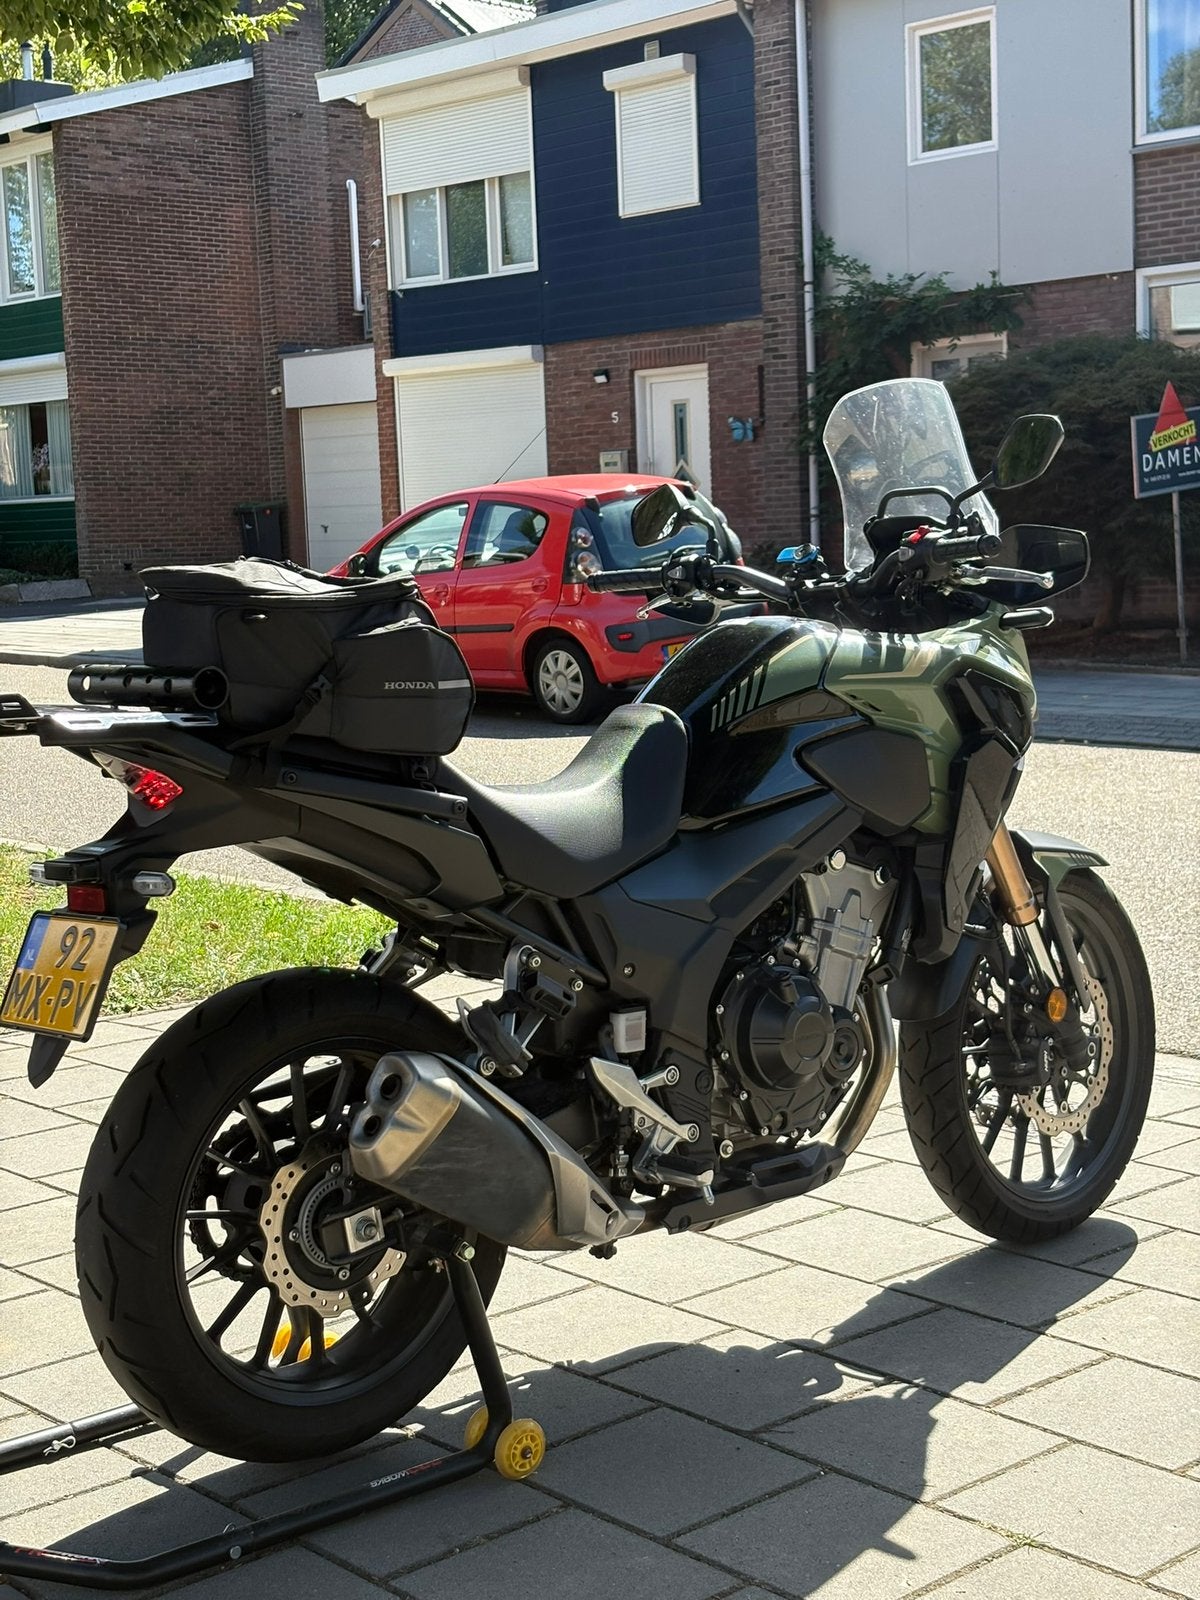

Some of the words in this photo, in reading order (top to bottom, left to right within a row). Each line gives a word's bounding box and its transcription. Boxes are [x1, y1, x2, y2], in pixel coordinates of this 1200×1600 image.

[611, 411, 619, 423] 5
[1152, 423, 1194, 448] VERKOCHT
[384, 681, 436, 690] HONDA
[24, 948, 35, 961] NL
[55, 925, 97, 972] 92
[2, 972, 99, 1028] MX-PV
